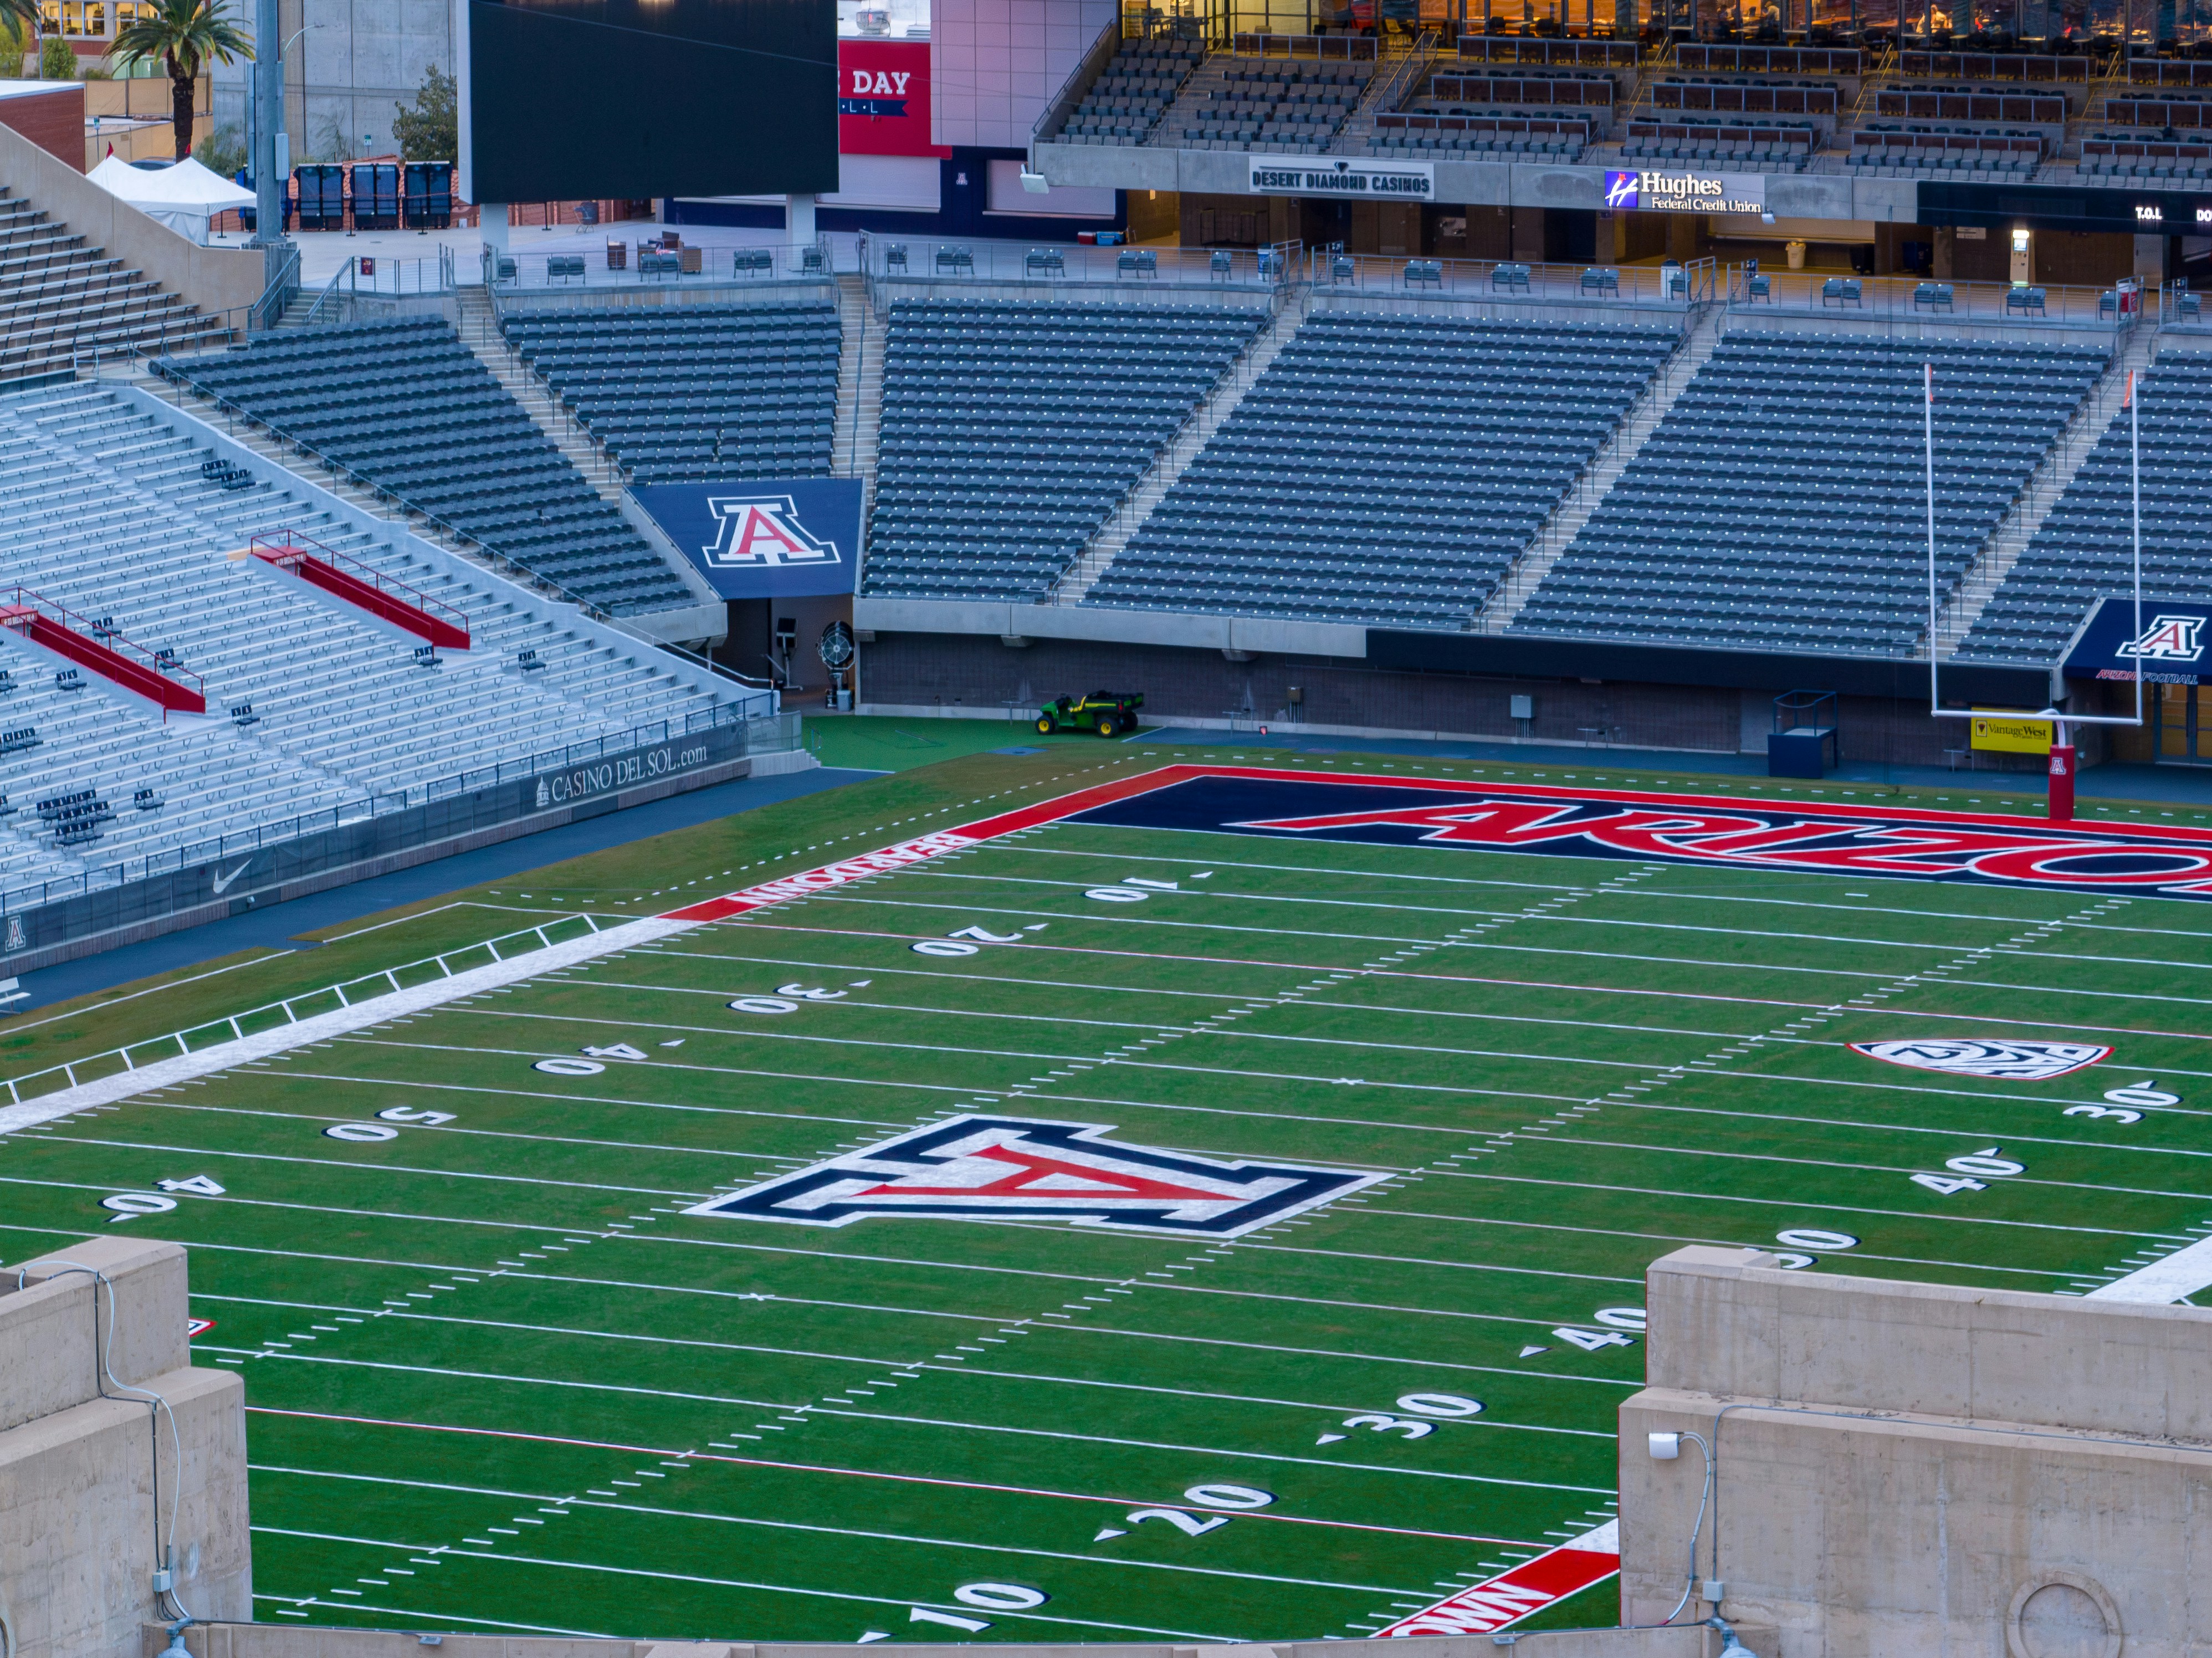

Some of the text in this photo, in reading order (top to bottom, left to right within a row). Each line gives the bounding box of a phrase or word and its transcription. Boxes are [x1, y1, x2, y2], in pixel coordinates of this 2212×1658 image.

[853, 70, 910, 95] DAY
[1252, 171, 1430, 192] DESERT DIAMOND CASINOS
[1641, 172, 1723, 199] Hughes
[1651, 197, 1761, 213] Federal Credit Union
[2196, 209, 2212, 222] DO
[2096, 669, 2198, 685] ARIZON FOOTBALL
[552, 746, 708, 802] CASINO DEL SOL.com
[1220, 800, 2212, 893] ARIZO
[1081, 877, 1178, 902] 10
[908, 925, 1024, 956] 20
[725, 983, 848, 1014] 30
[530, 1042, 649, 1076] 40
[2062, 1088, 2184, 1124] 30
[321, 1107, 458, 1142] 50
[1909, 1156, 2029, 1195] 40
[97, 1174, 226, 1214] 40
[1552, 1307, 1647, 1351] 40
[1342, 1393, 1488, 1440] 30
[1126, 1484, 1279, 1537] 20
[909, 1582, 1053, 1633] 10
